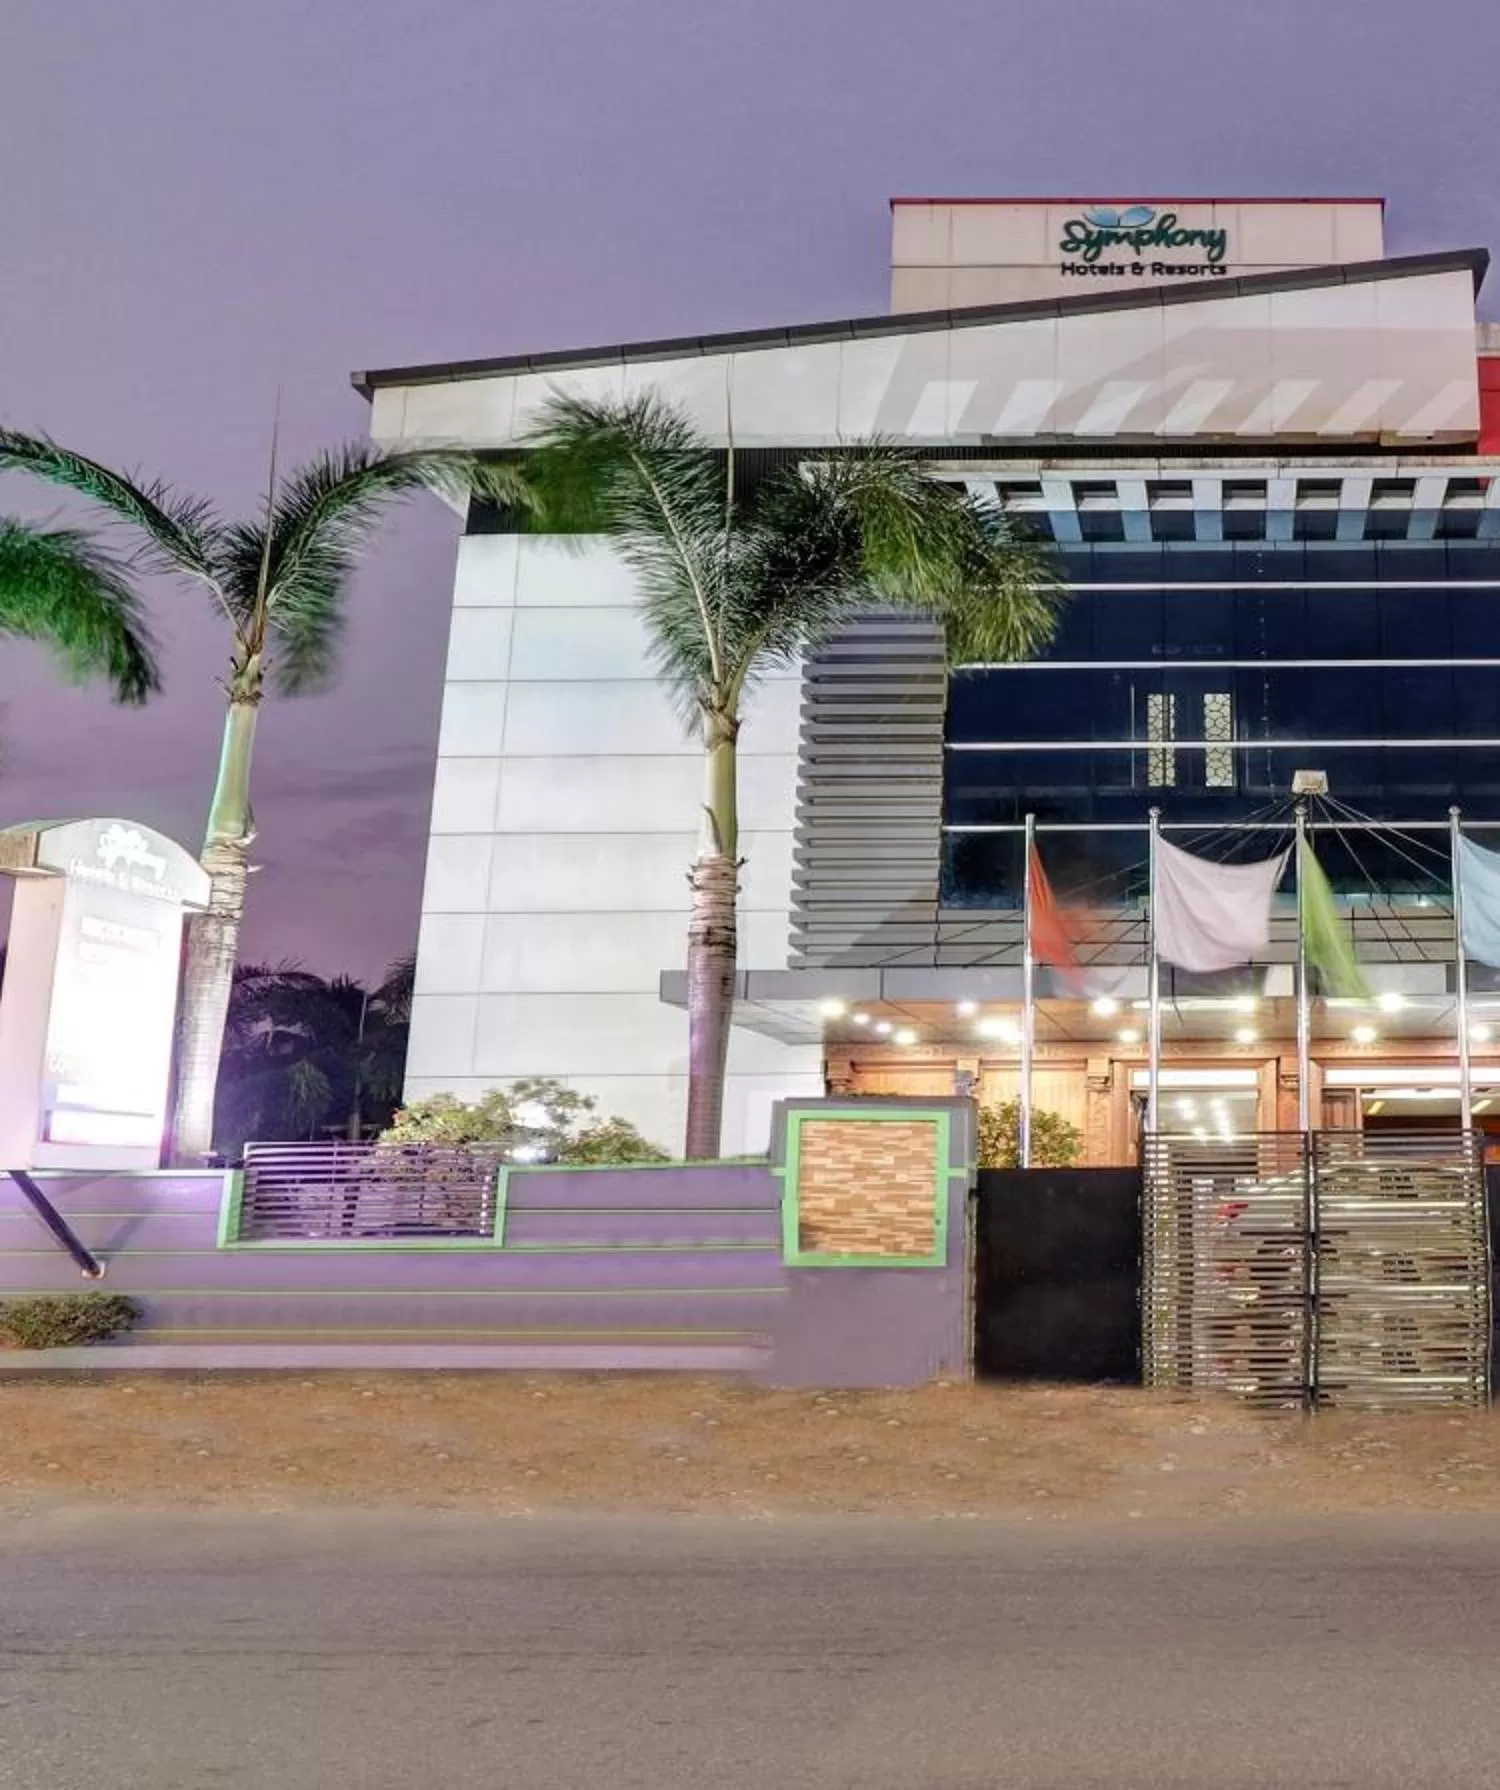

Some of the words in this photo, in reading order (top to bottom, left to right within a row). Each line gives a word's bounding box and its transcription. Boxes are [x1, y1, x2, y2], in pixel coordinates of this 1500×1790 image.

[1059, 213, 1227, 263] Symphony
[1061, 262, 1125, 276] Hotels
[1131, 262, 1145, 276] &
[1151, 262, 1227, 276] Resorts
